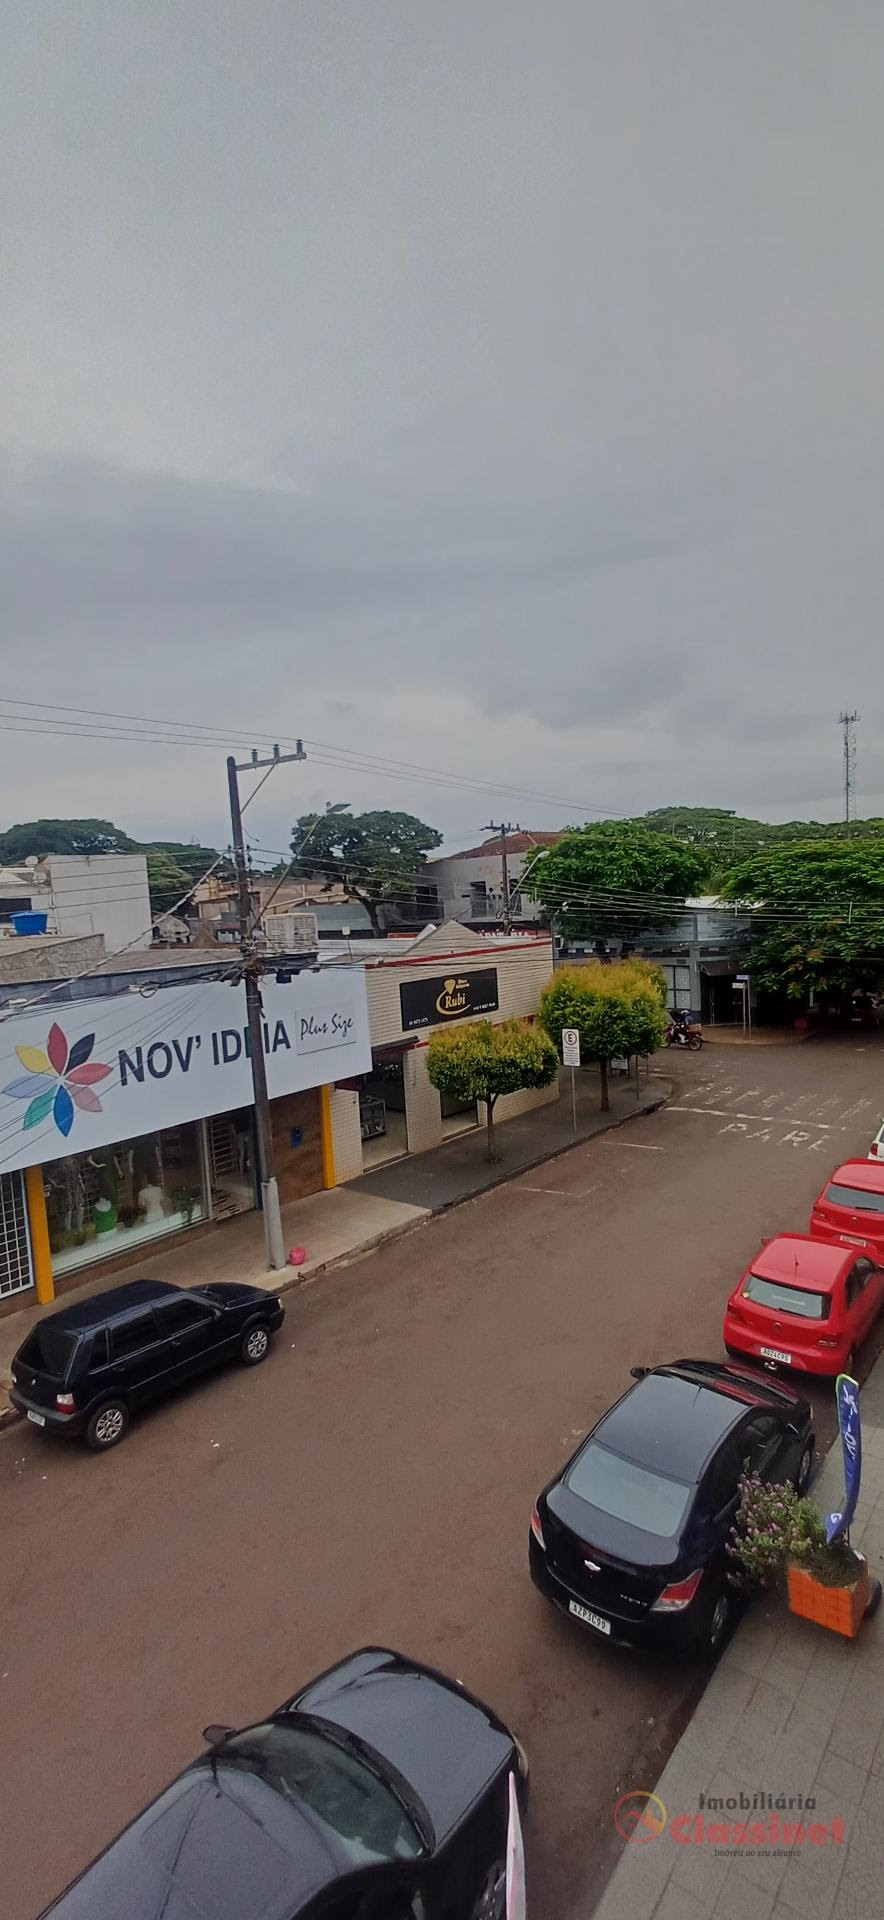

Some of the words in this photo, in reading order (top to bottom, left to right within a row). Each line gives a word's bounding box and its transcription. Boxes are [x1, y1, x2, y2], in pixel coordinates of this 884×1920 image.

[445, 993, 466, 1009] Rubi
[300, 1016, 329, 1040] Plus
[331, 1013, 353, 1038] Size
[118, 1035, 201, 1086] NOV'
[716, 1122, 832, 1152] PARE
[572, 1603, 606, 1630] AZP3C99
